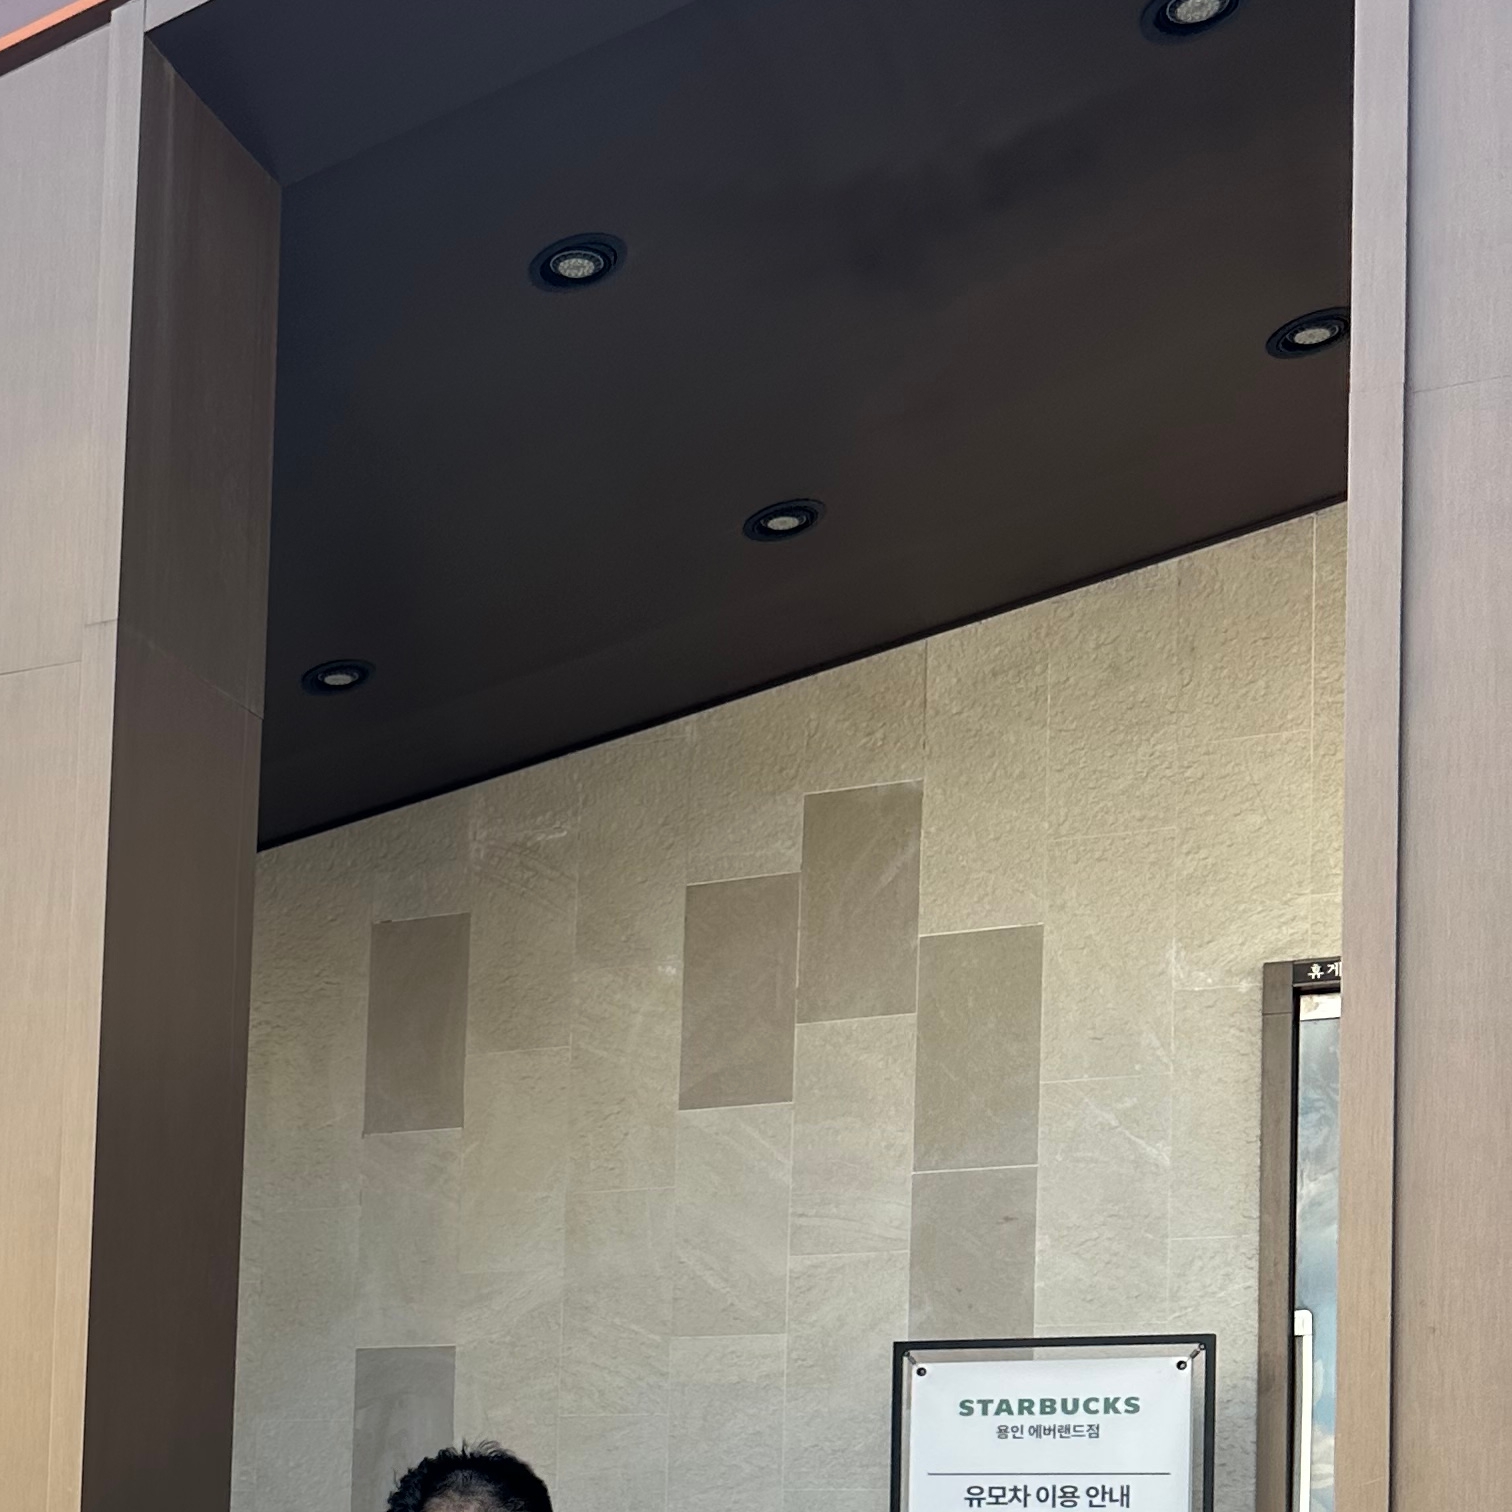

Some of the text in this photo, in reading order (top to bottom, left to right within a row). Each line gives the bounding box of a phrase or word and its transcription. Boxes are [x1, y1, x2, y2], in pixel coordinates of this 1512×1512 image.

[959, 1396, 1141, 1417] STARBUCKS
[996, 1423, 1101, 1440] 용인 에버랜드점
[964, 1484, 1130, 1508] 유모차 이용 안내
